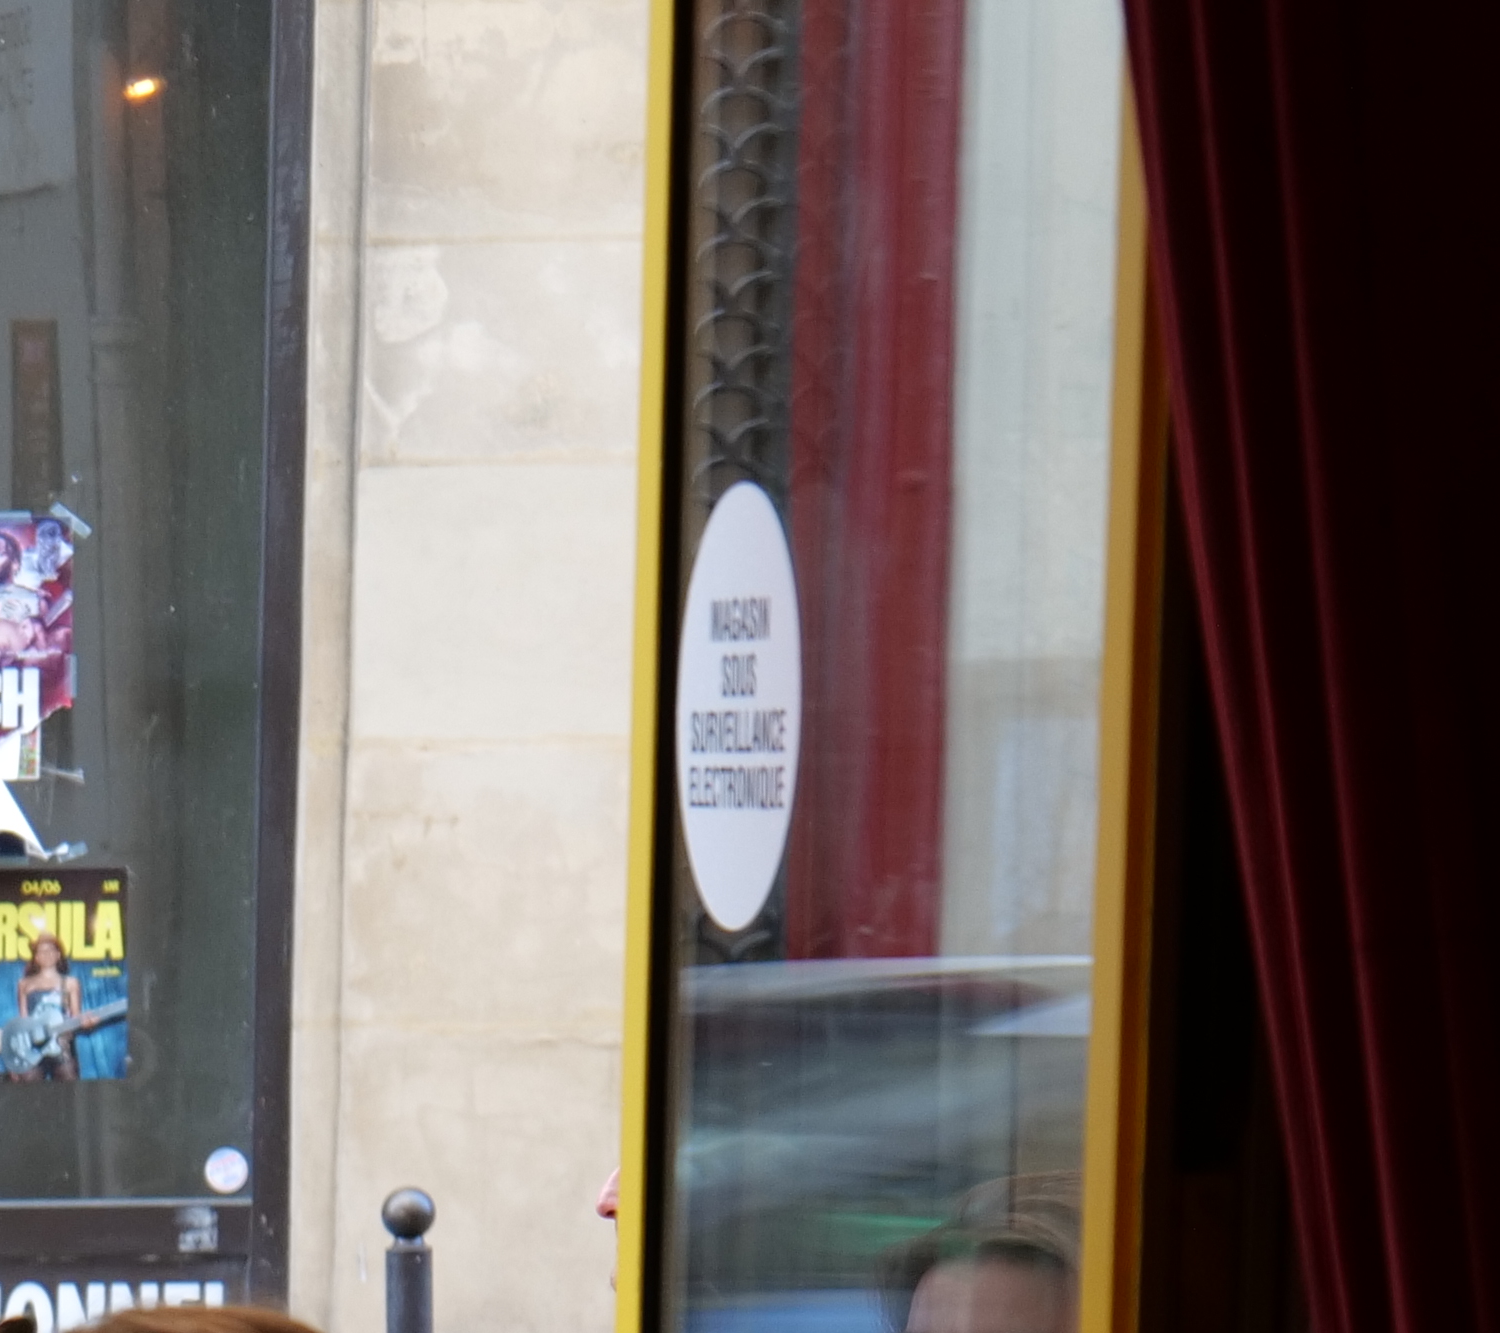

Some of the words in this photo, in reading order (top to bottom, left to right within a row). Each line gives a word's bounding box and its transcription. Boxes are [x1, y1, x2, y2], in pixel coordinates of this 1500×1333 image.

[709, 597, 771, 642] MAGASIN
[721, 654, 758, 698] SOUS
[690, 710, 788, 754] SURVEILLANCE
[688, 766, 786, 809] ELECTRONIQUE
